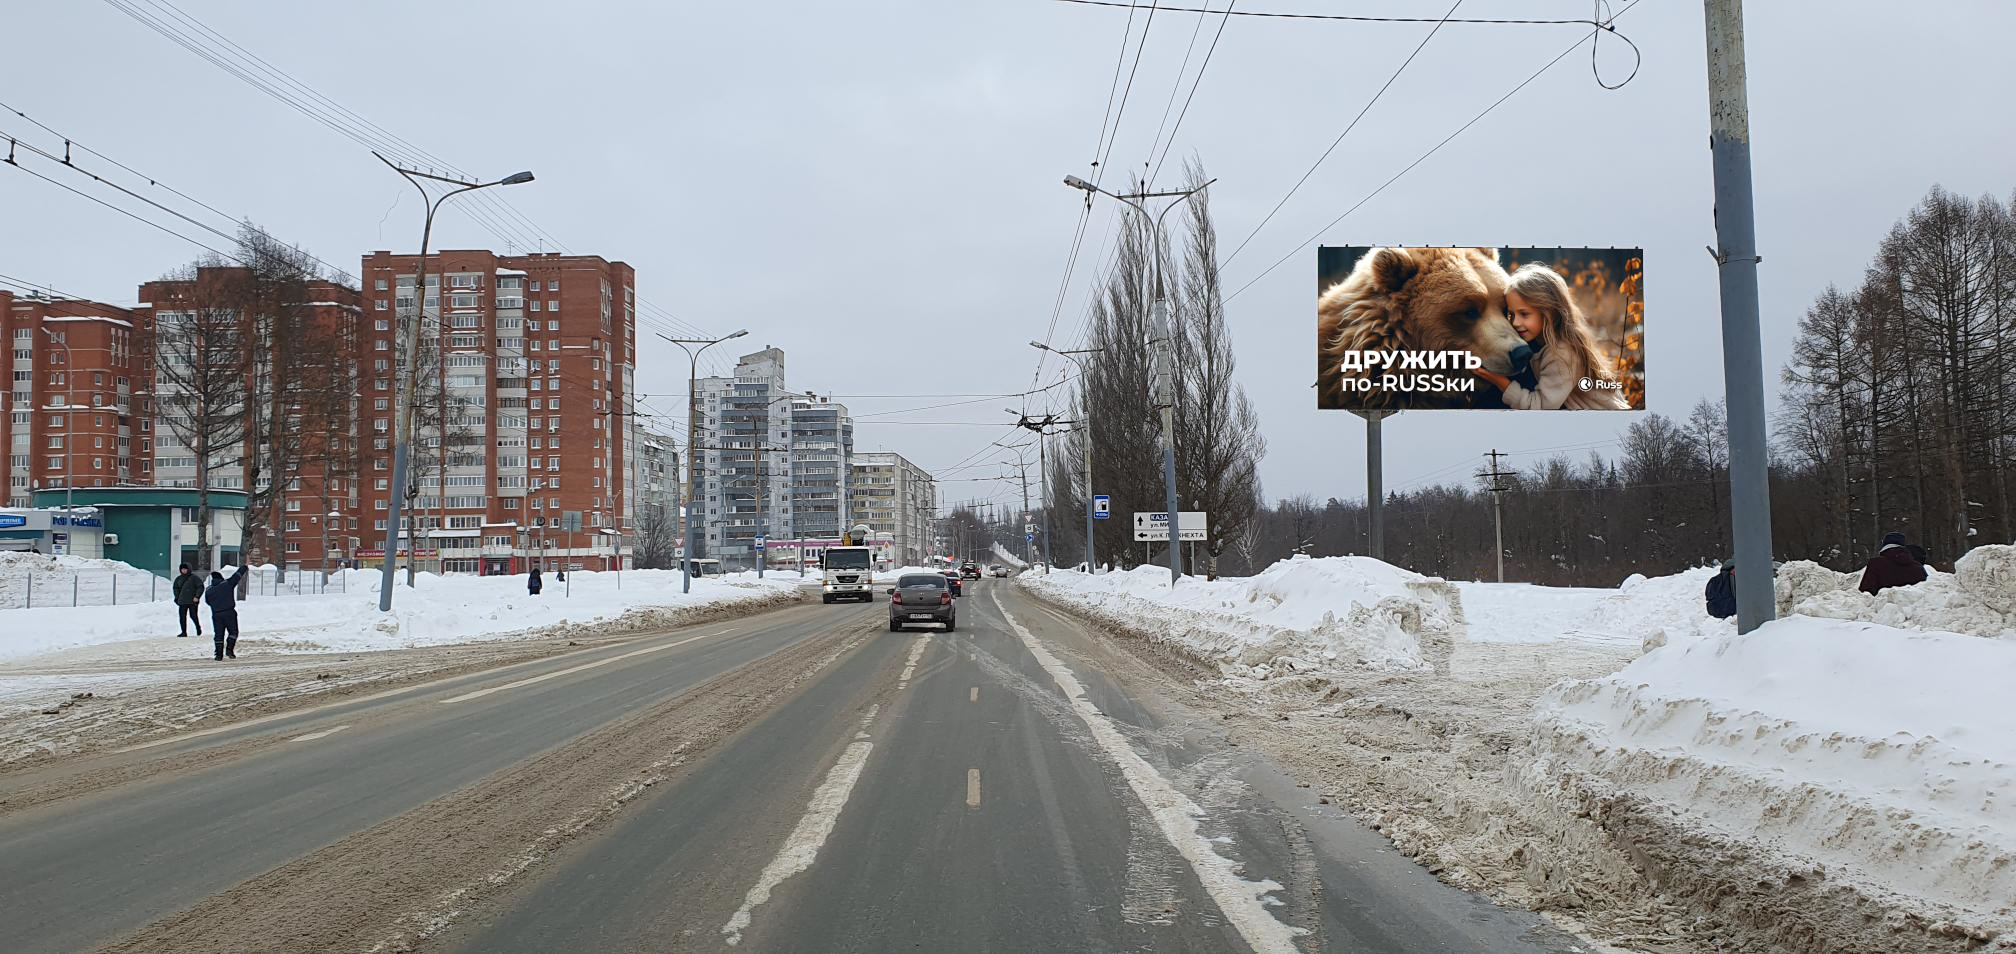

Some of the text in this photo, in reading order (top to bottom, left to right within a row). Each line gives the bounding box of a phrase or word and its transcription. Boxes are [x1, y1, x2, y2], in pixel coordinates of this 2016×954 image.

[1341, 350, 1482, 372] ДРУЖИТЬ
[1342, 374, 1475, 392] по-RUSSки
[1596, 379, 1623, 389] Russ
